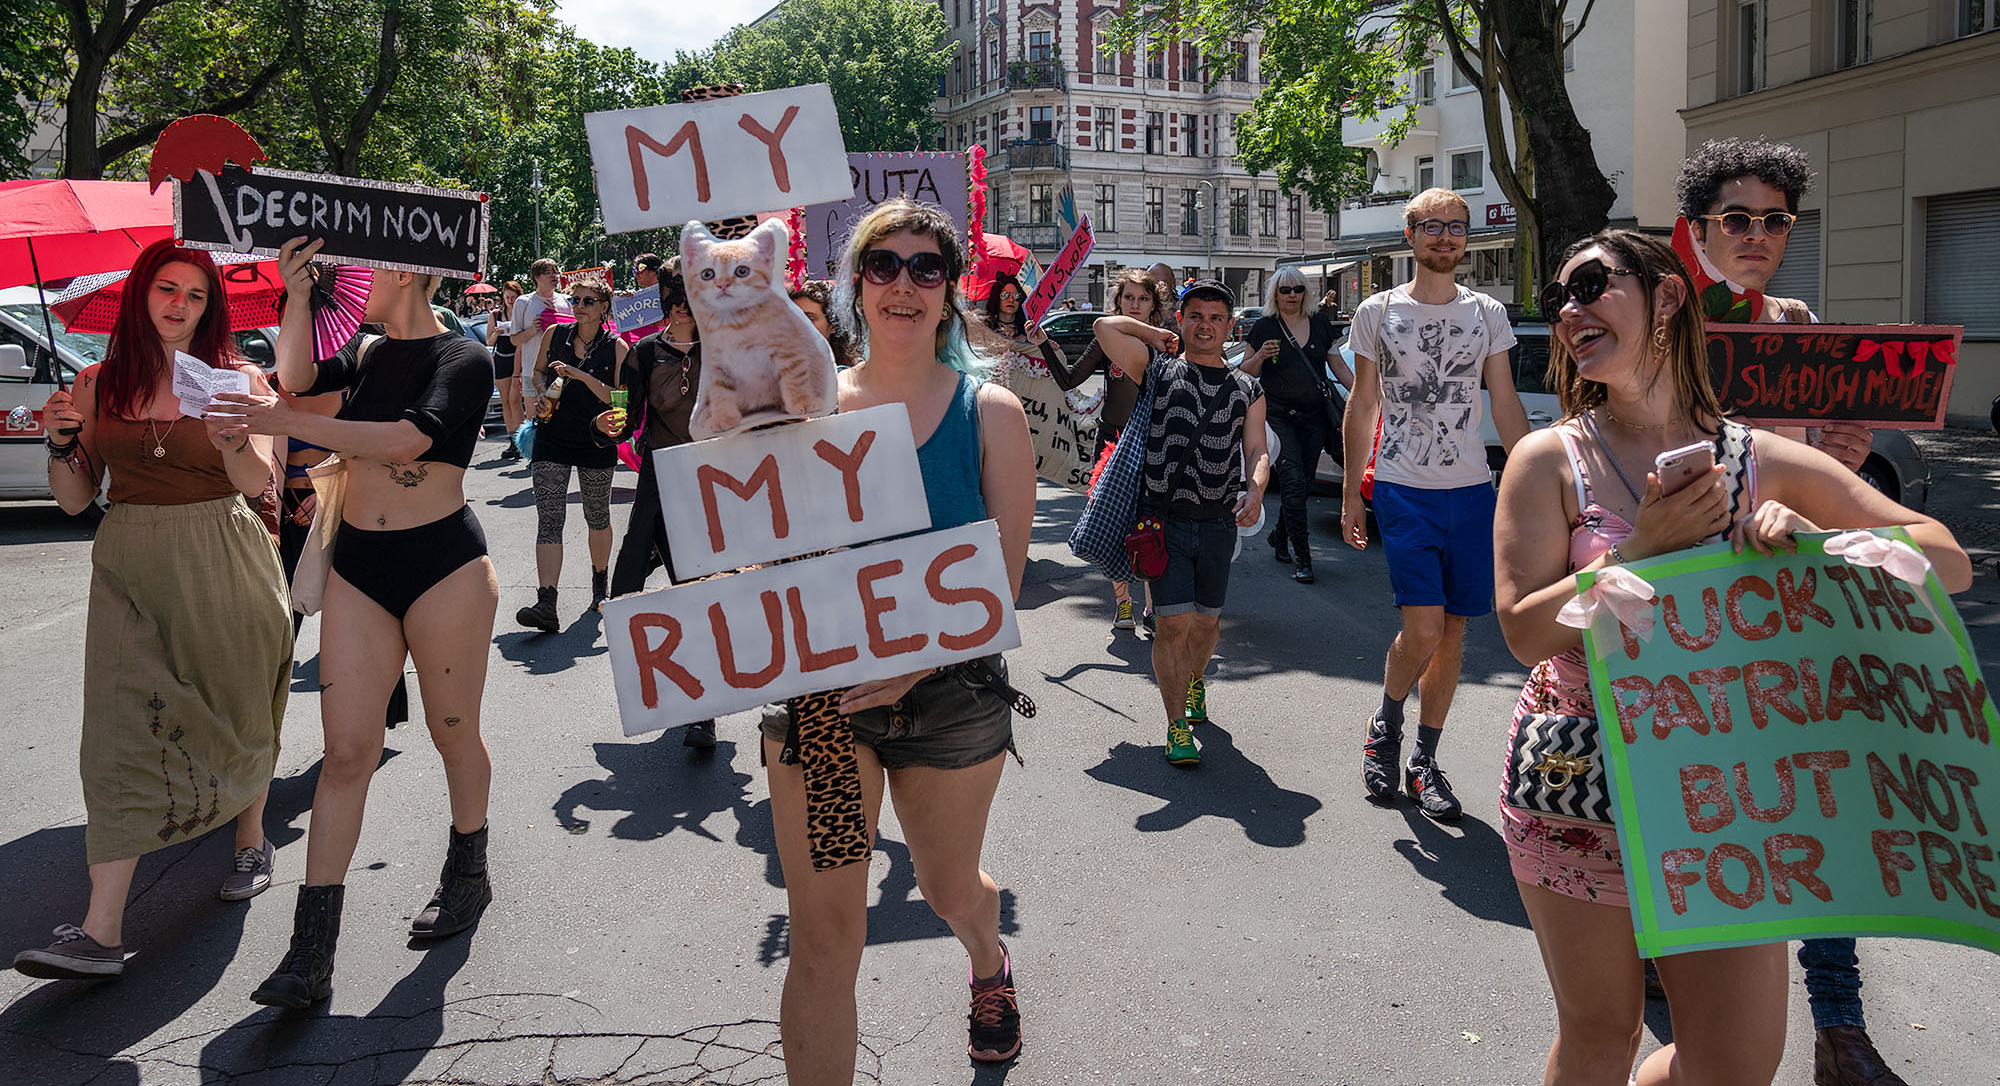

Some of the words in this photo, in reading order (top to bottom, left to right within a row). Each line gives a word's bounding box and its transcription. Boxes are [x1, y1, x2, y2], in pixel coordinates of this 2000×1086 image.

[625, 106, 799, 211] MY
[236, 185, 371, 238] DECRIM
[383, 206, 477, 263] NOW!
[1065, 217, 1091, 277] WORK
[1500, 204, 1517, 217] Kie
[616, 298, 660, 321] WHORE
[1750, 334, 1784, 356] TO
[1797, 334, 1853, 359] THE
[1736, 363, 1861, 416] SWEDISH
[1051, 431, 1070, 453] im
[698, 430, 876, 553] MY
[630, 544, 1003, 709] RULES
[1824, 565, 1935, 634] THE
[1610, 654, 1990, 745] PATRIARCHY
[1679, 750, 1850, 833] BUT
[1865, 752, 1988, 836] NOT
[1661, 833, 1834, 915] FOR
[1871, 830, 2000, 918] FRE
